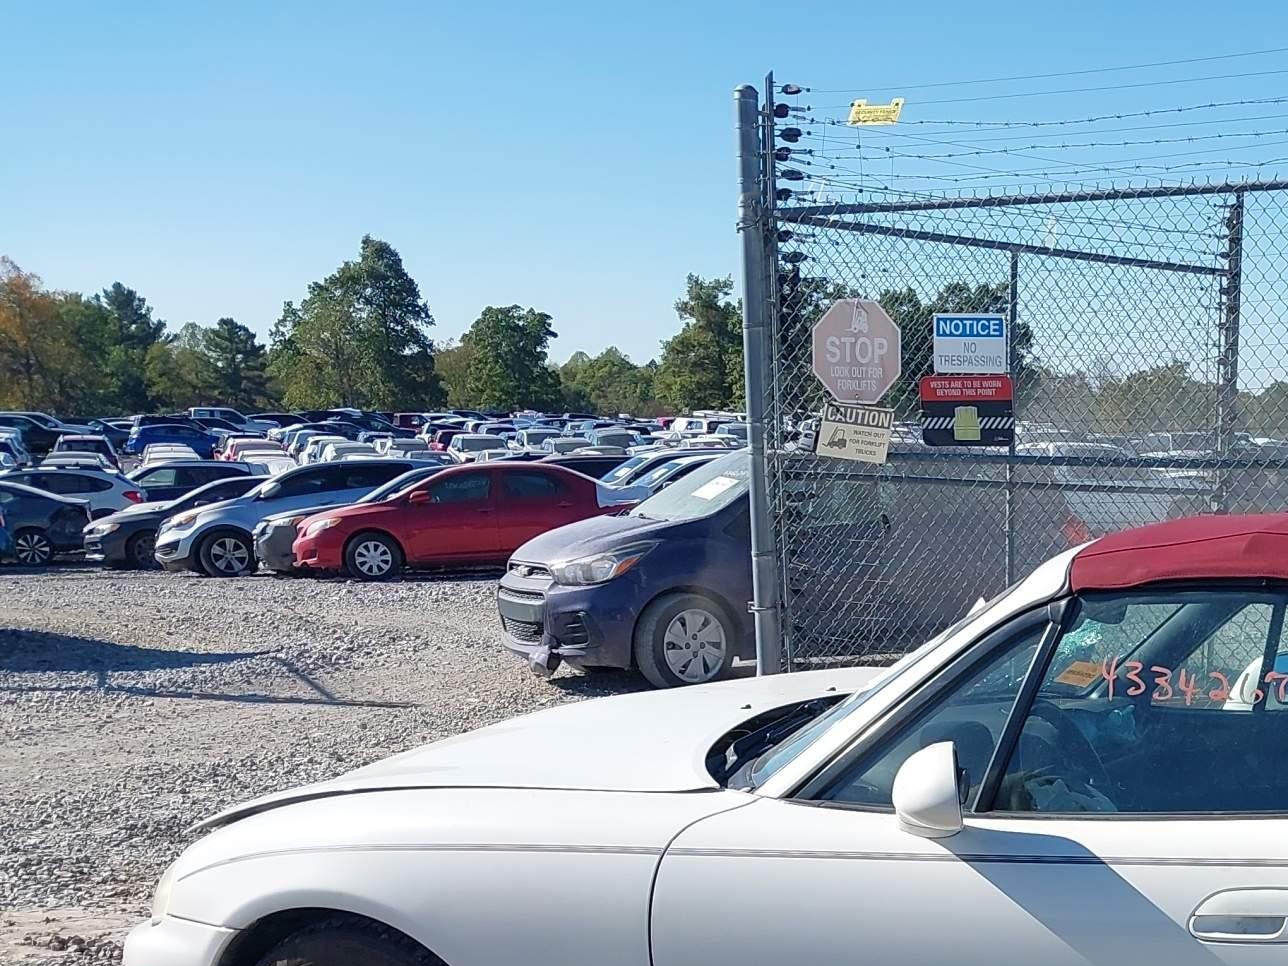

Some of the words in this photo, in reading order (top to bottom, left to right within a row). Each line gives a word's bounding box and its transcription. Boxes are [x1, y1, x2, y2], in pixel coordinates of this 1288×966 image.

[939, 319, 1000, 336] NOTICE
[826, 336, 888, 364] STOP
[963, 342, 977, 353] NO
[939, 354, 1003, 367] TRESPASSING
[830, 366, 850, 377] LOOK
[851, 367, 867, 378] OUT
[868, 367, 883, 378] FOR
[837, 380, 877, 391] FORKLIFTS
[936, 388, 962, 396] BEYOND
[827, 408, 890, 428] CAUTION
[853, 430, 873, 438] WATCH
[861, 439, 886, 449] FORKLIFT
